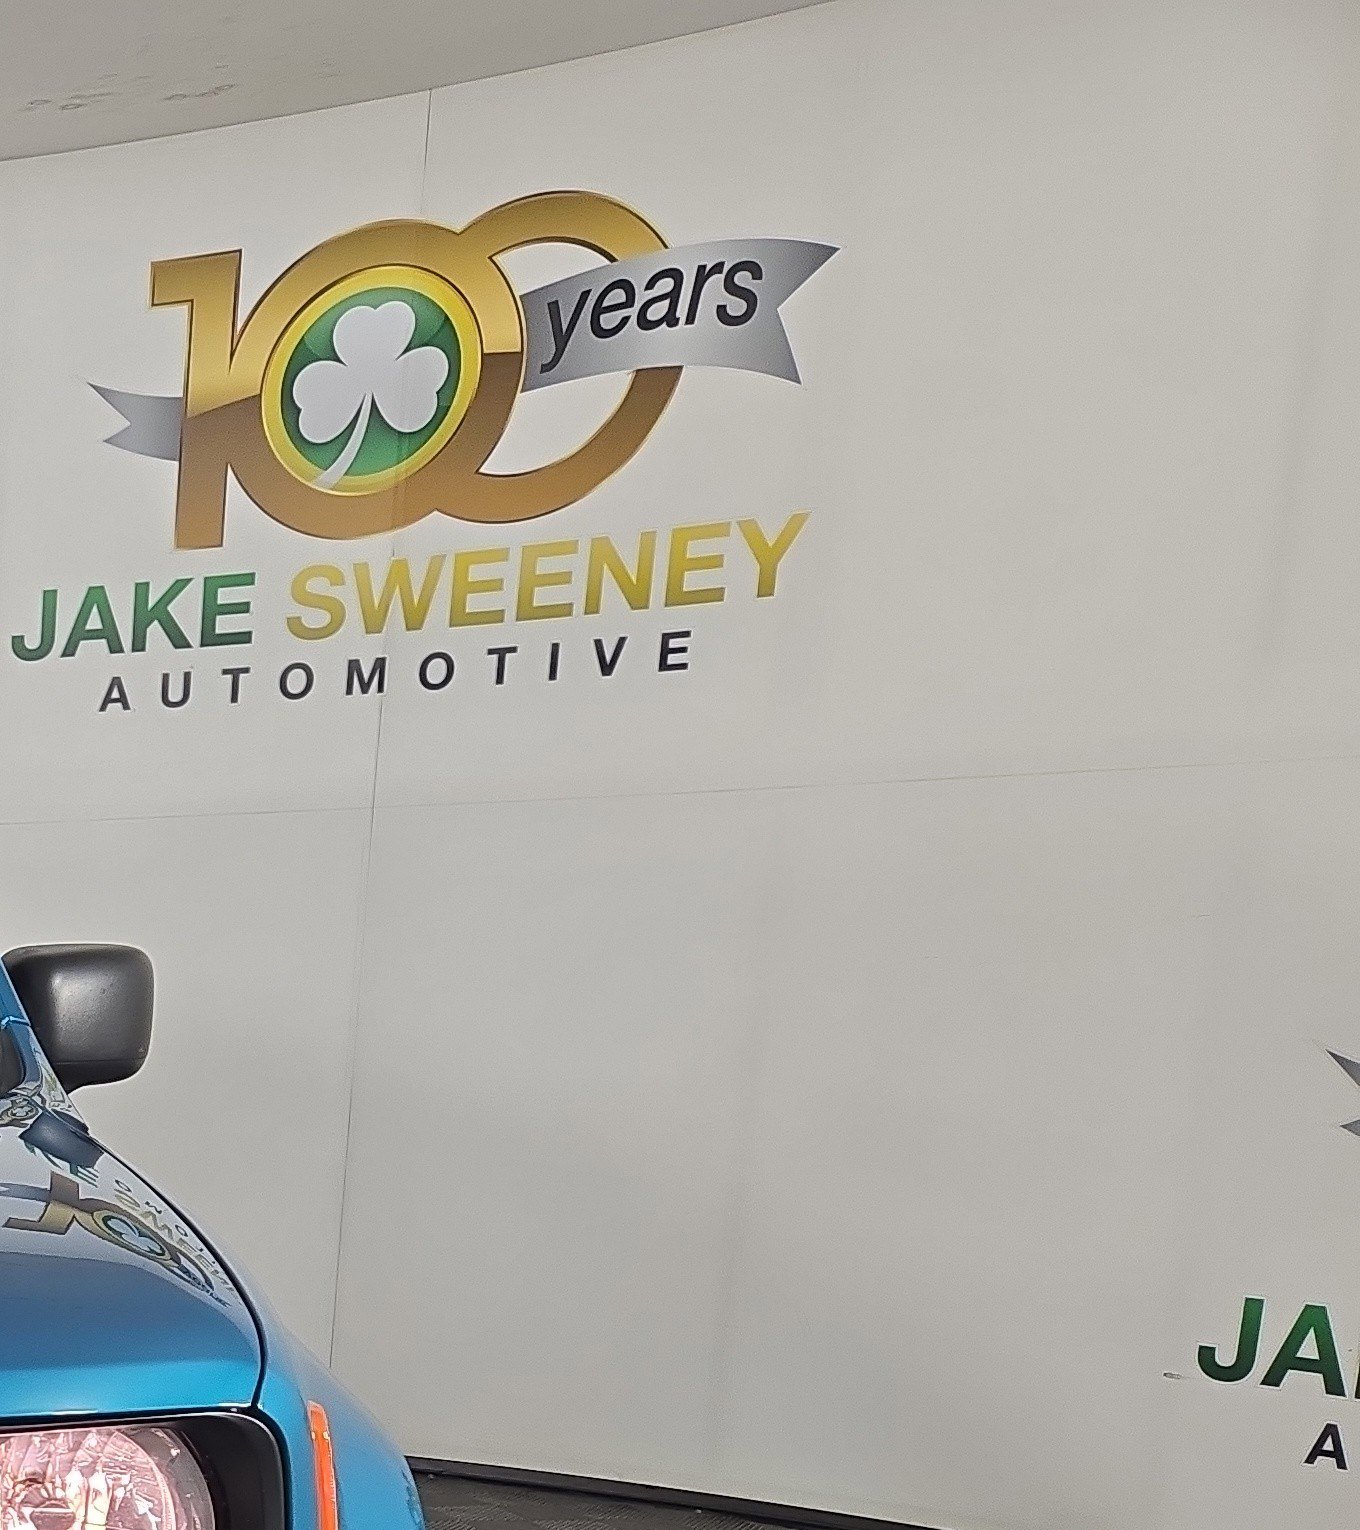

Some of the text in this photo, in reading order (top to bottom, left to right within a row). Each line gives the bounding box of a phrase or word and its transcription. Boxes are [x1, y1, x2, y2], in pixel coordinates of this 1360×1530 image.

[540, 258, 761, 374] years
[10, 511, 812, 662] JAKE SWEENEY
[99, 630, 692, 713] AUTOMOTIVE
[1197, 1297, 1360, 1399] JA
